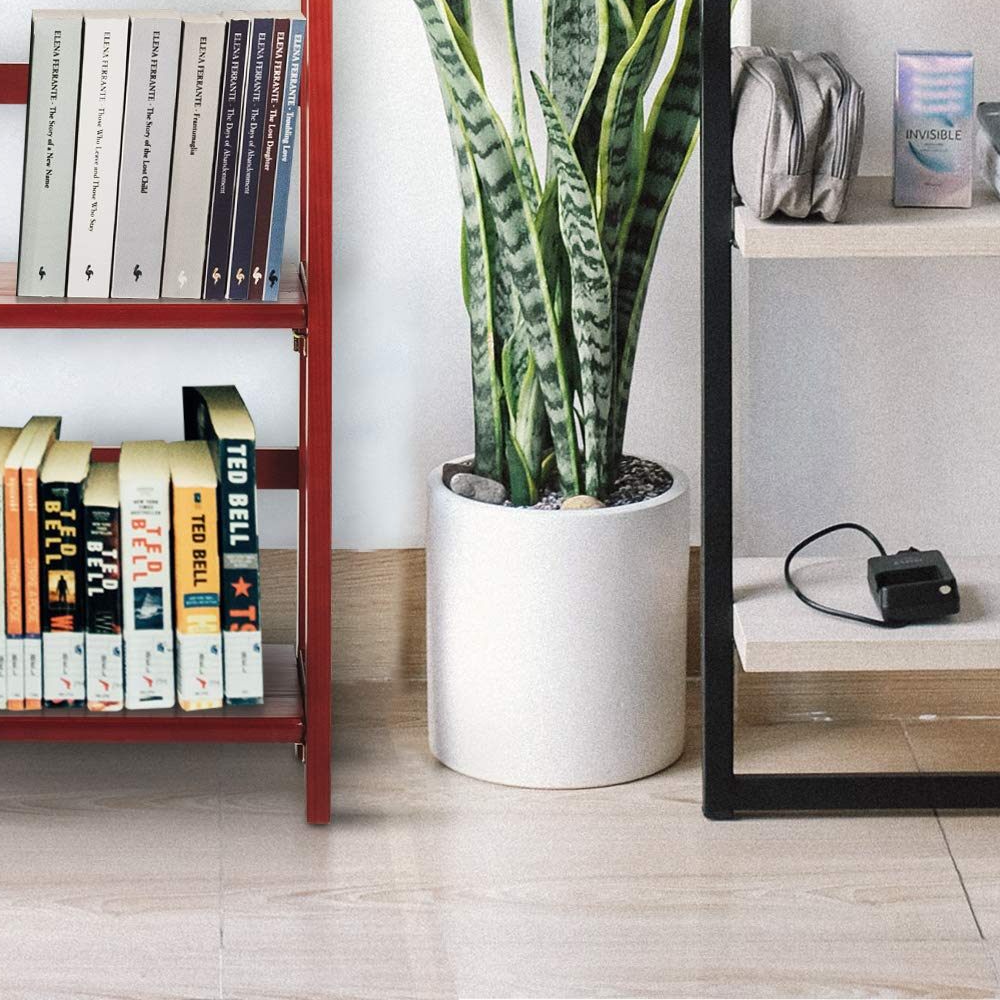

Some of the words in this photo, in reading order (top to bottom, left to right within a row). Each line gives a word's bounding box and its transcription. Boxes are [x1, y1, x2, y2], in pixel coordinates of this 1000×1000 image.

[52, 30, 62, 57] ELENA
[102, 31, 111, 58] ELENA
[151, 31, 160, 58] ELENA
[198, 36, 207, 64] ELENA
[232, 32, 242, 60] ELENA
[256, 32, 266, 60] ELENA
[274, 31, 285, 59] ELENA
[292, 34, 302, 62] ELENA
[50, 58, 60, 101] FERRANTE
[99, 60, 109, 101] FERRANTE
[148, 59, 158, 102] FERRANTE
[194, 65, 205, 108] FERRANTE
[228, 61, 239, 103] FERRANTE
[252, 61, 264, 102] FERRANTE
[270, 60, 282, 104] FERRANTE
[287, 63, 299, 107] FERRANTE
[48, 107, 57, 119] The
[97, 108, 105, 127] Those
[146, 107, 154, 120] The
[227, 109, 235, 121] The
[251, 109, 259, 121] The
[269, 110, 278, 123] The
[46, 120, 56, 138] Story
[95, 129, 104, 145] Who
[143, 121, 153, 138] Story
[224, 122, 234, 140] Days
[248, 122, 258, 139] Days
[267, 124, 276, 139] Lost
[282, 112, 294, 144] Troubling
[906, 129, 962, 141] INVISIBLE
[47, 139, 54, 147] of
[93, 146, 102, 165] Leave
[142, 147, 151, 159] the
[144, 139, 152, 148] of
[263, 140, 275, 171] Daughter
[281, 144, 290, 162] Love
[46, 152, 54, 167] New
[141, 160, 150, 175] Lost
[220, 148, 231, 194] Abandonment
[244, 148, 255, 194] Abandonment
[44, 169, 53, 189] Name
[91, 181, 100, 200] Those
[140, 175, 149, 194] Child
[90, 201, 98, 218] Who
[88, 218, 96, 232] Stay
[227, 444, 248, 484] TED
[44, 501, 62, 565] BELL
[60, 509, 77, 556] TED
[192, 514, 206, 543] TED
[228, 493, 250, 546] BELL
[131, 519, 148, 582] BELL
[146, 527, 162, 572] TED
[87, 541, 104, 597] BELL
[102, 549, 119, 590] TED
[192, 550, 207, 587] BELL
